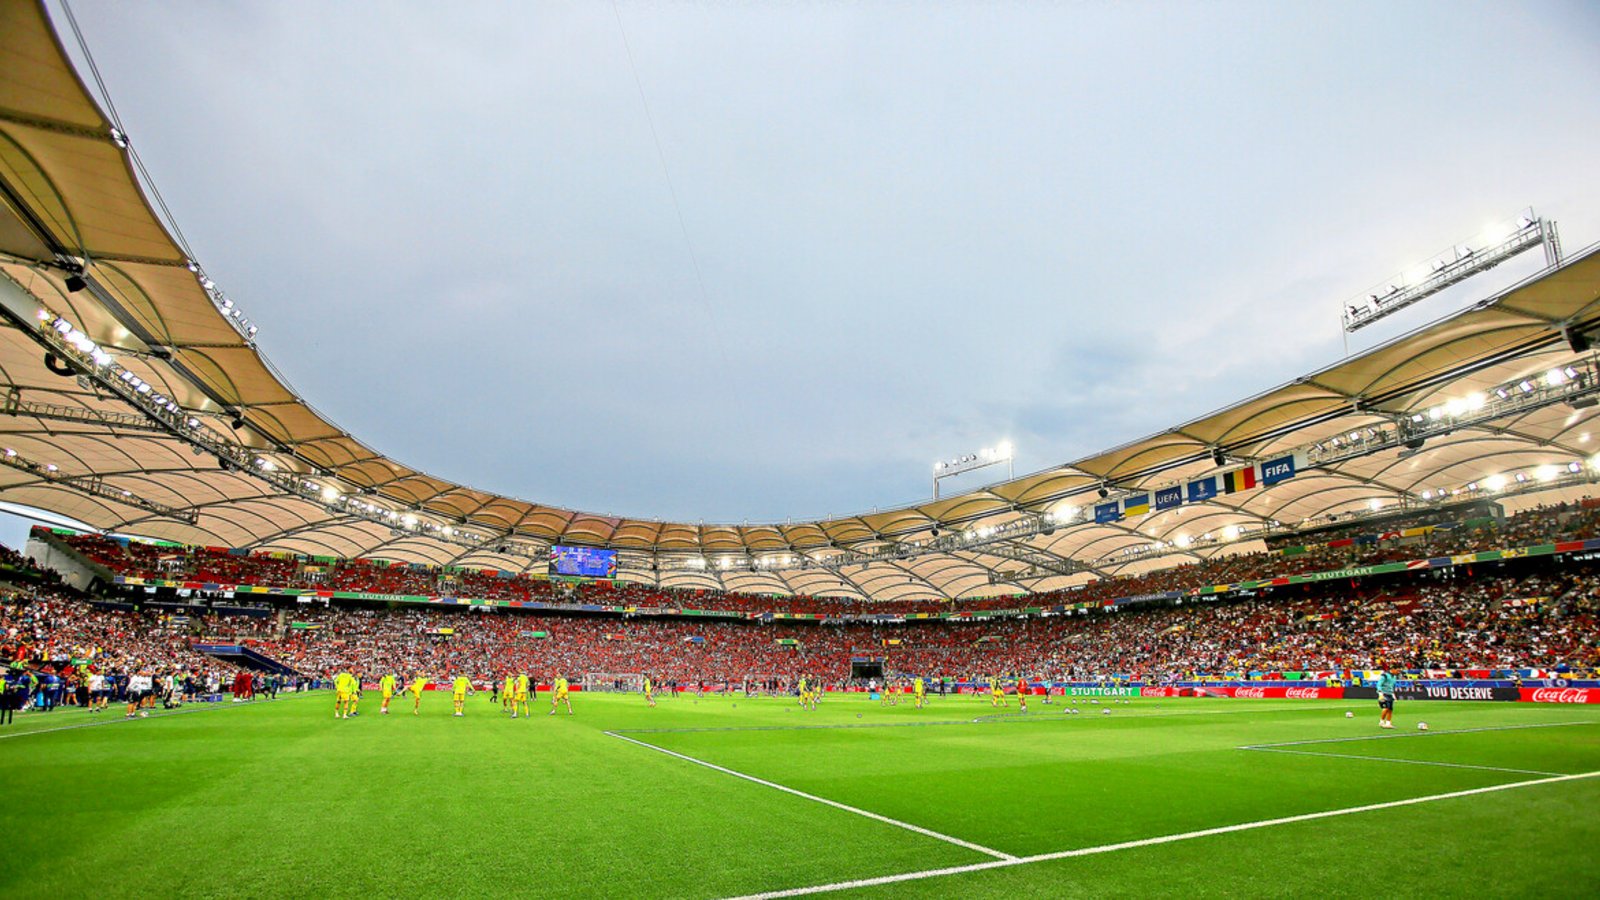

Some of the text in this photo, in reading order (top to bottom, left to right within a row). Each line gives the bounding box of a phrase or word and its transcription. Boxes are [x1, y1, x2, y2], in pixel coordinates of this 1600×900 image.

[1265, 463, 1290, 478] FIFA
[1157, 492, 1180, 504] UEFA
[1316, 567, 1374, 579] STUTTGART
[1071, 687, 1133, 696] STUTTGART
[1450, 687, 1494, 699] DESERVE
[1532, 688, 1589, 703] Coca-Cola
